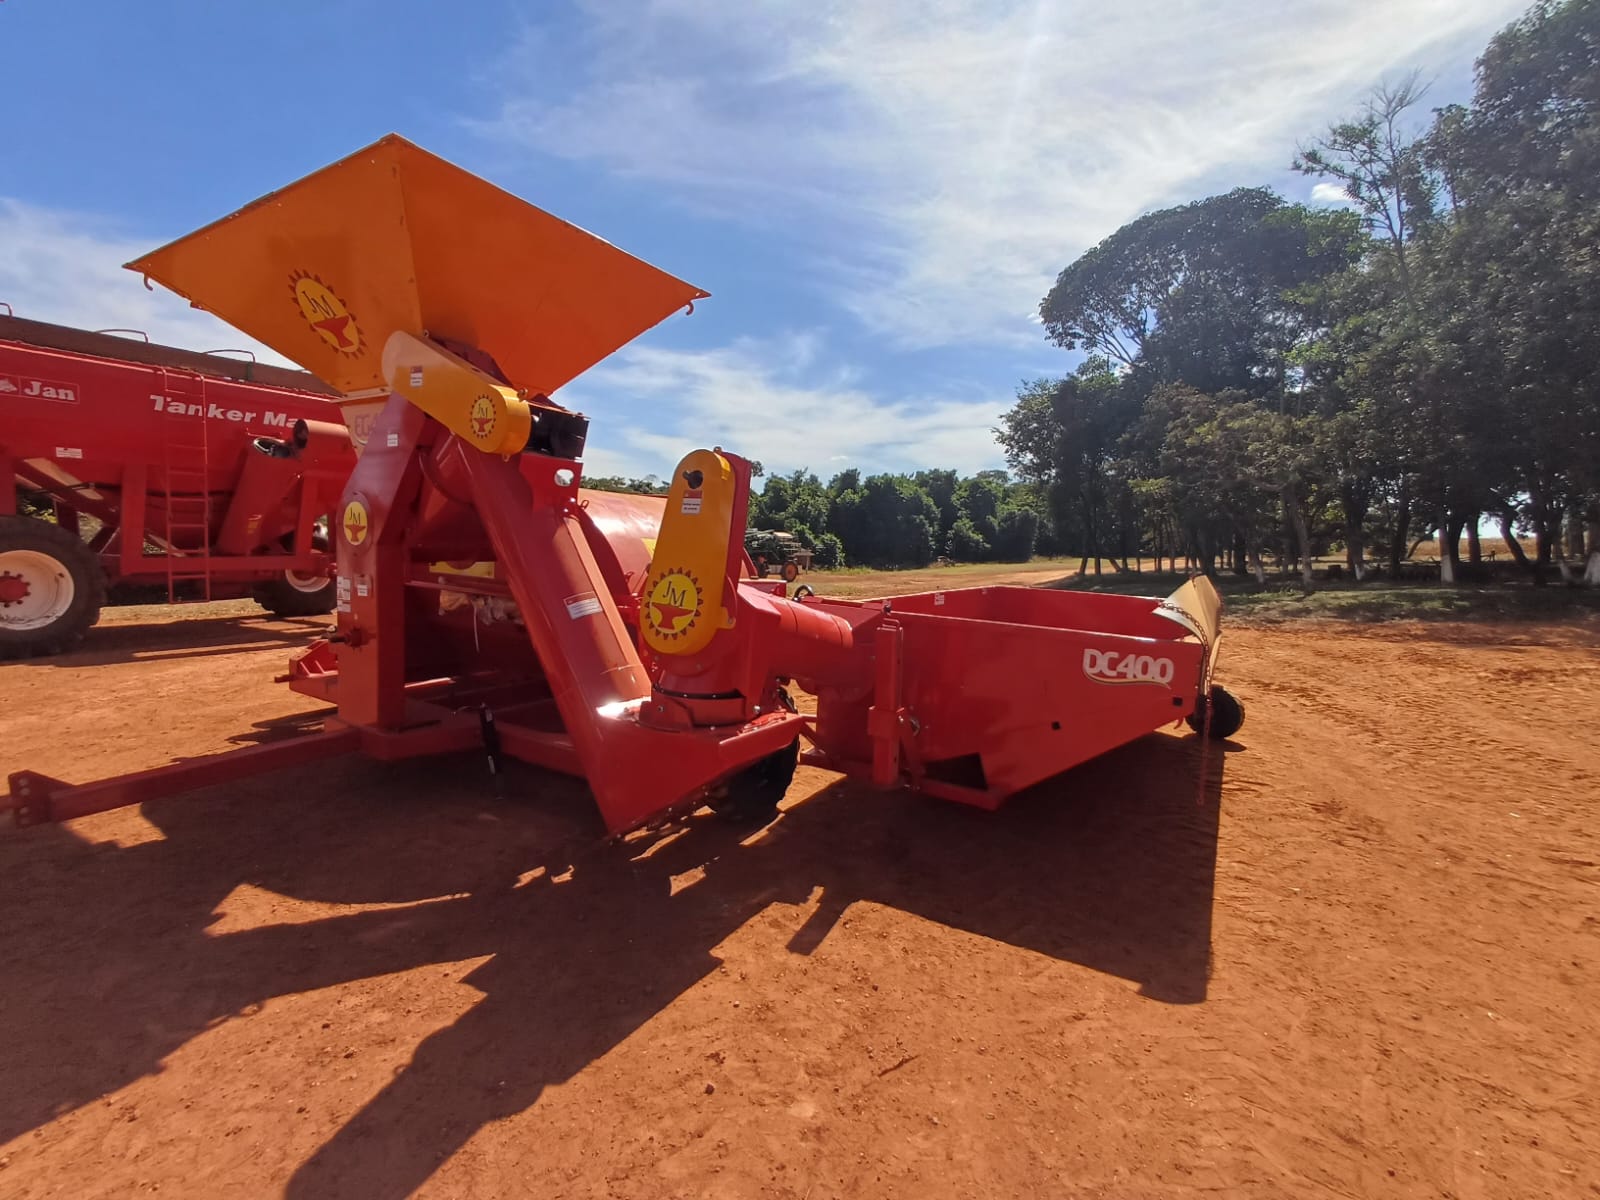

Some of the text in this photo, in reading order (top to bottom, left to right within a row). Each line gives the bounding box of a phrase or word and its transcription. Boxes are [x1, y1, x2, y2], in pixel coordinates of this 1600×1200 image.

[302, 290, 337, 319] JM
[24, 381, 76, 401] Jan
[150, 395, 257, 422] Tanker
[662, 581, 688, 607] JM
[1083, 648, 1175, 684] DC400
